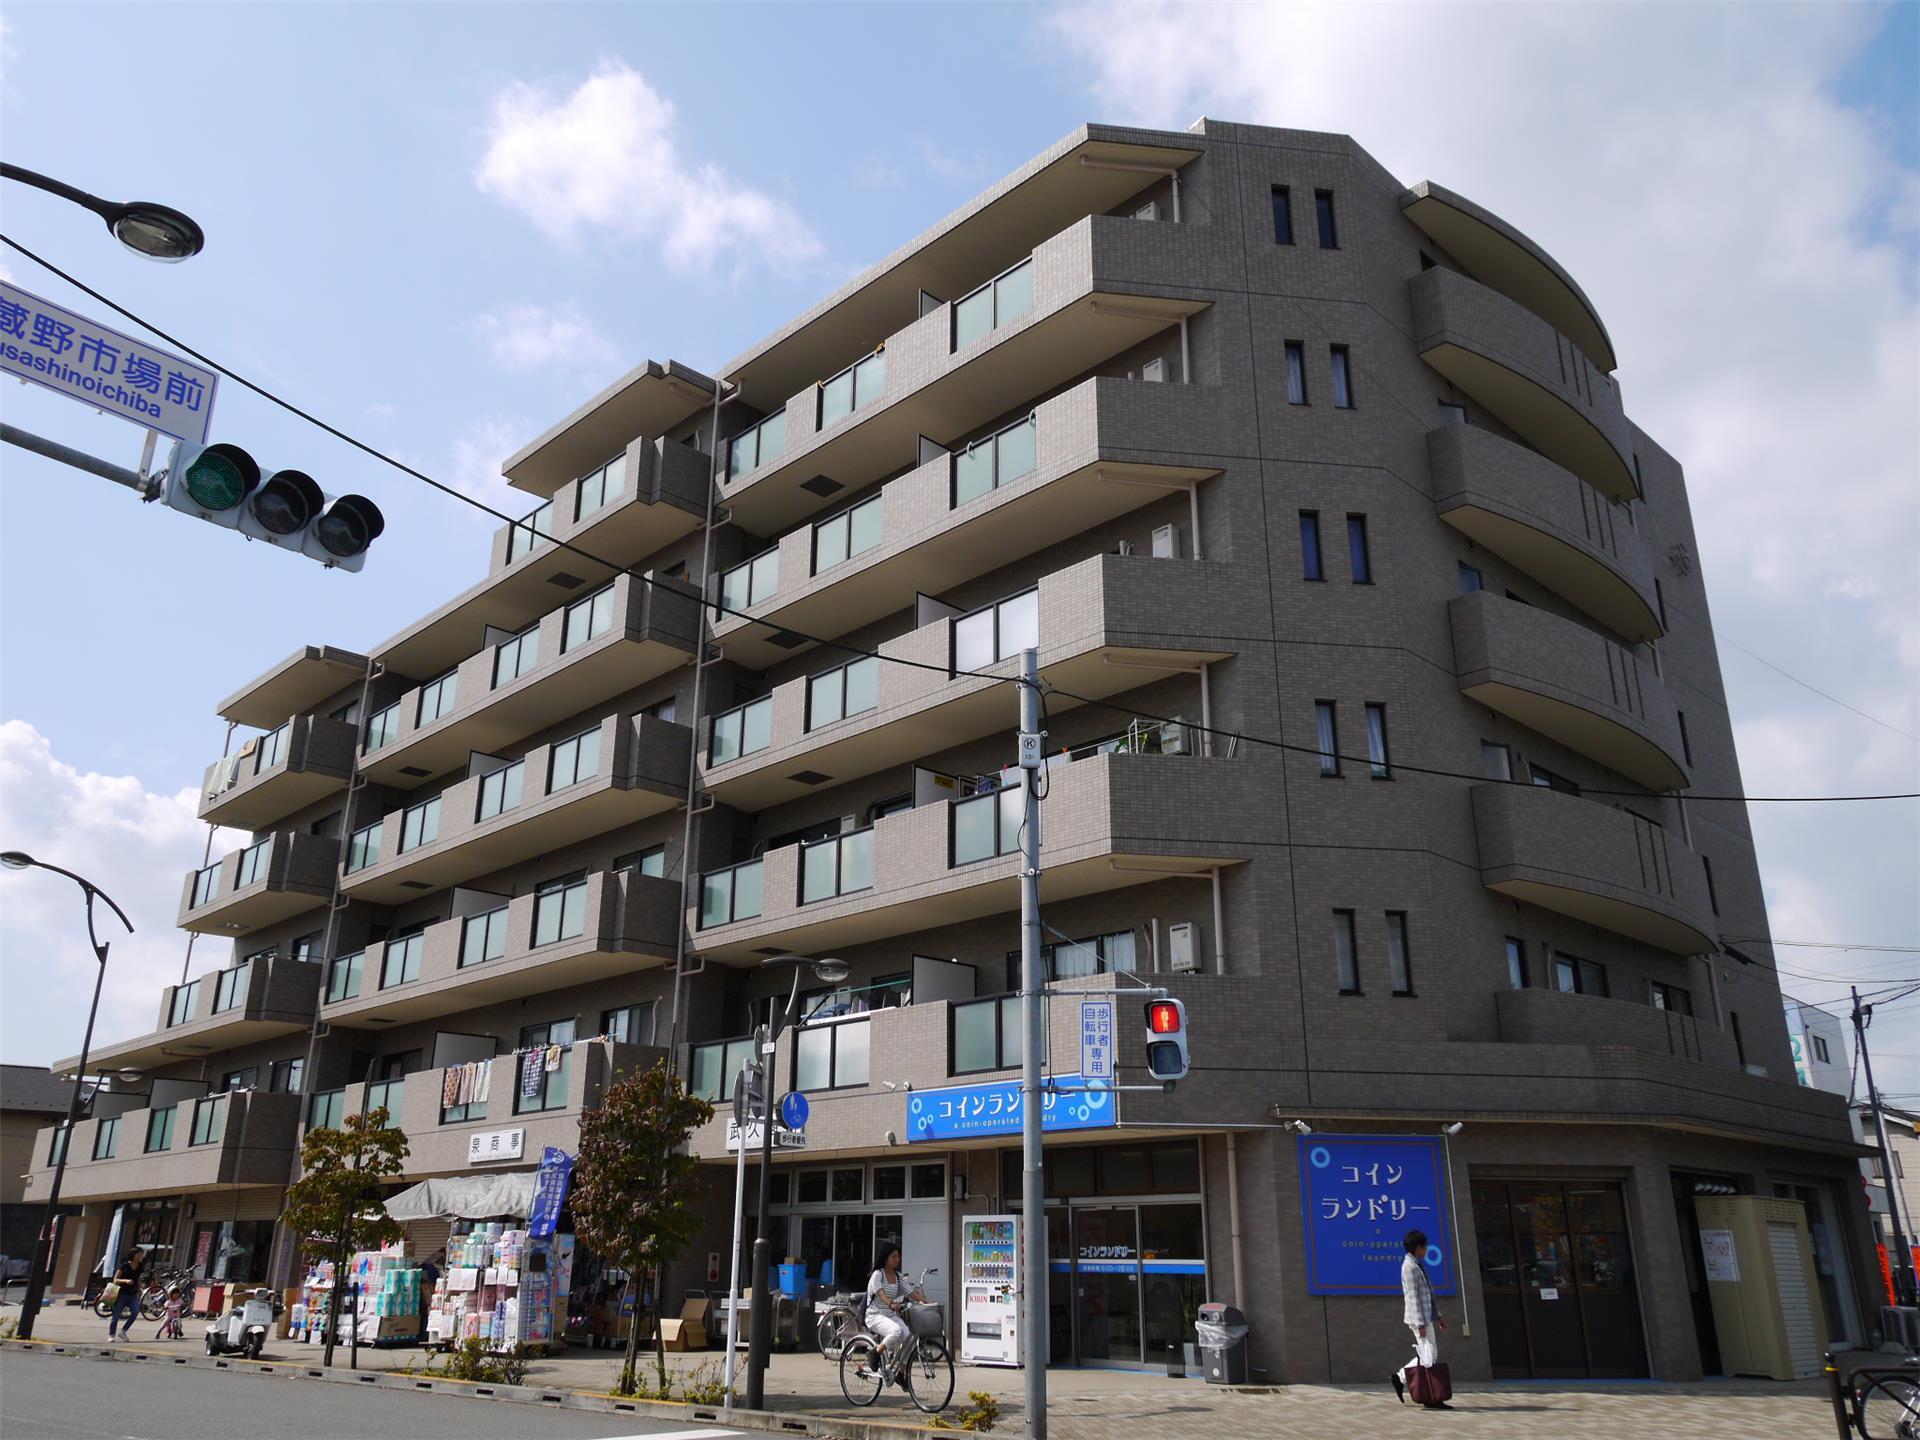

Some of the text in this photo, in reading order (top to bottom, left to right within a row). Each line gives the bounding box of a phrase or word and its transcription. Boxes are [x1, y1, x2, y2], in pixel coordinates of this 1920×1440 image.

[1085, 1007, 1096, 1046] 自転車
[1098, 1007, 1109, 1046] 歩行者
[1091, 1047, 1103, 1073] 専用
[939, 1092, 1076, 1119] コインランリー
[962, 1116, 1020, 1129] coin-operated
[1342, 1163, 1403, 1186] コイン
[1321, 1194, 1430, 1221] ランドリー
[1080, 1245, 1136, 1258] コインランドリー
